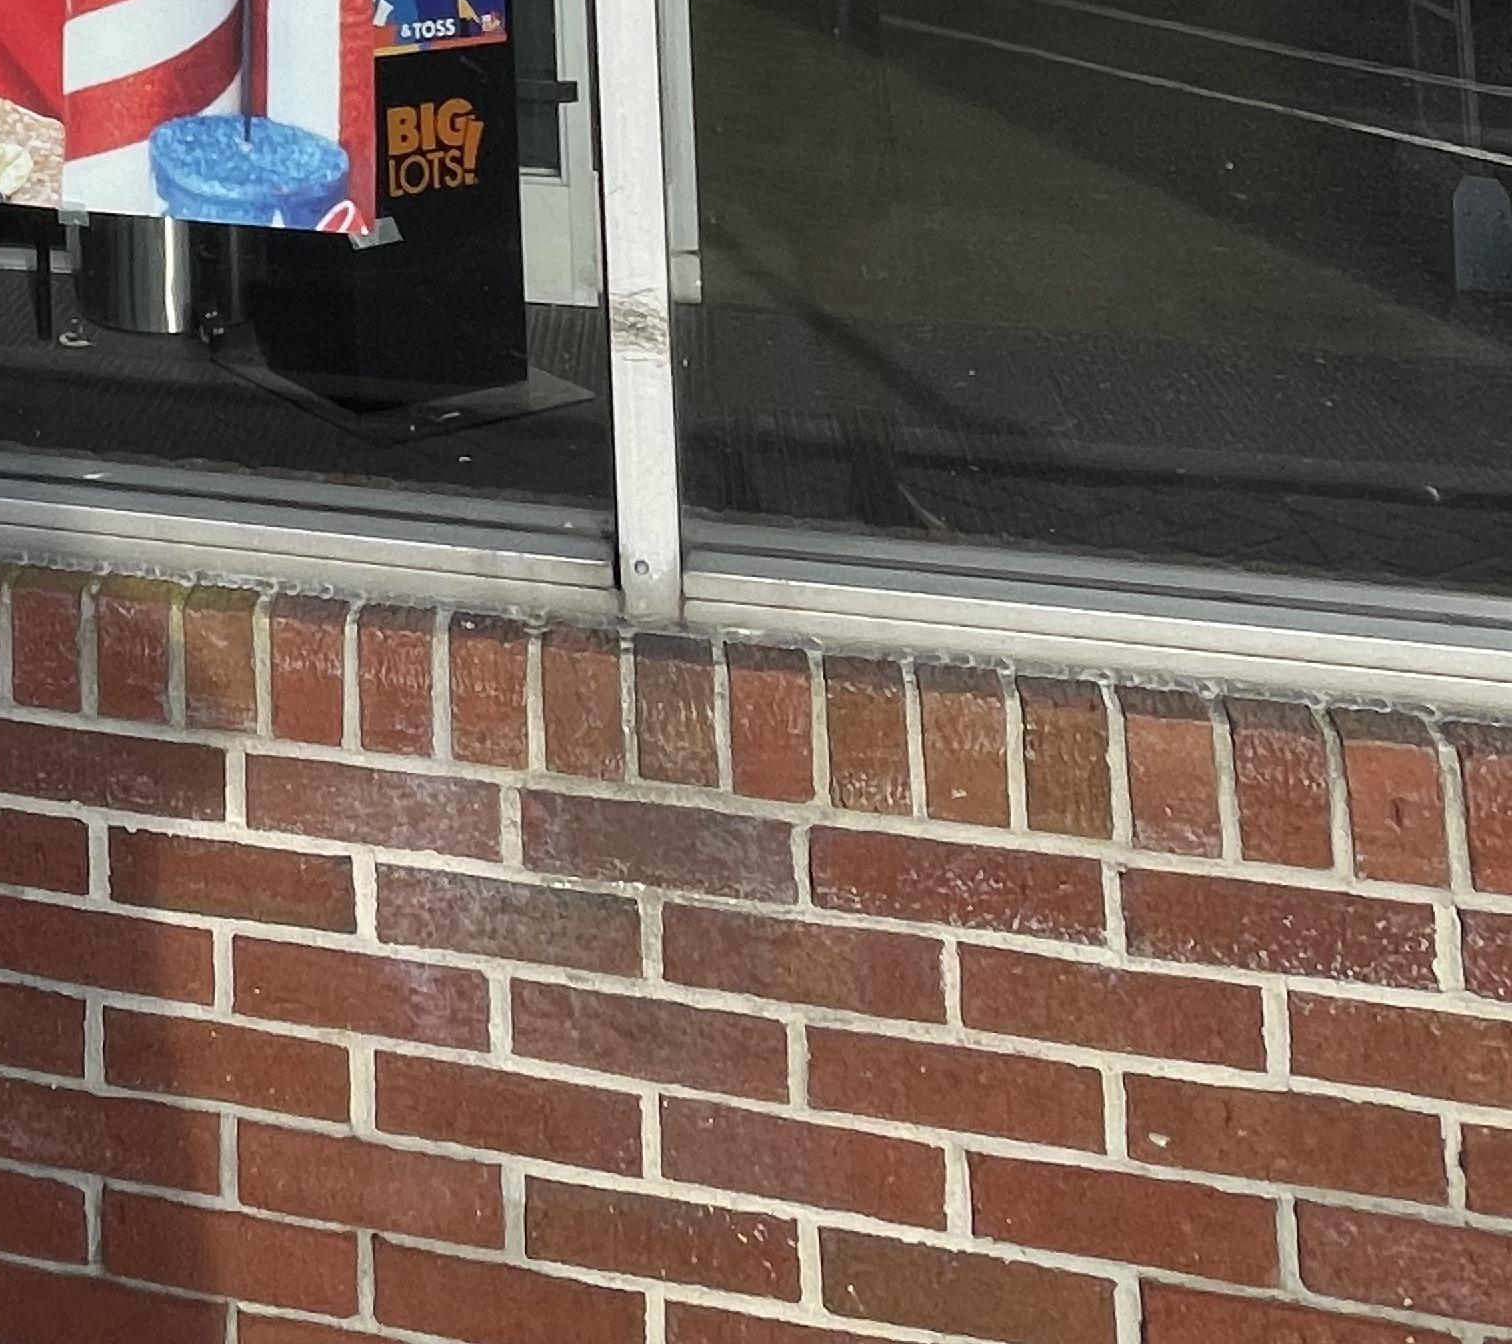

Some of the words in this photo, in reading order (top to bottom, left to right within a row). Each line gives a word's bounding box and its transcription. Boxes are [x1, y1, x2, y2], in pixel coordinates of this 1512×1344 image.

[413, 18, 455, 39] TOSS
[387, 98, 476, 156] BIG
[388, 116, 484, 198] LOTS!
